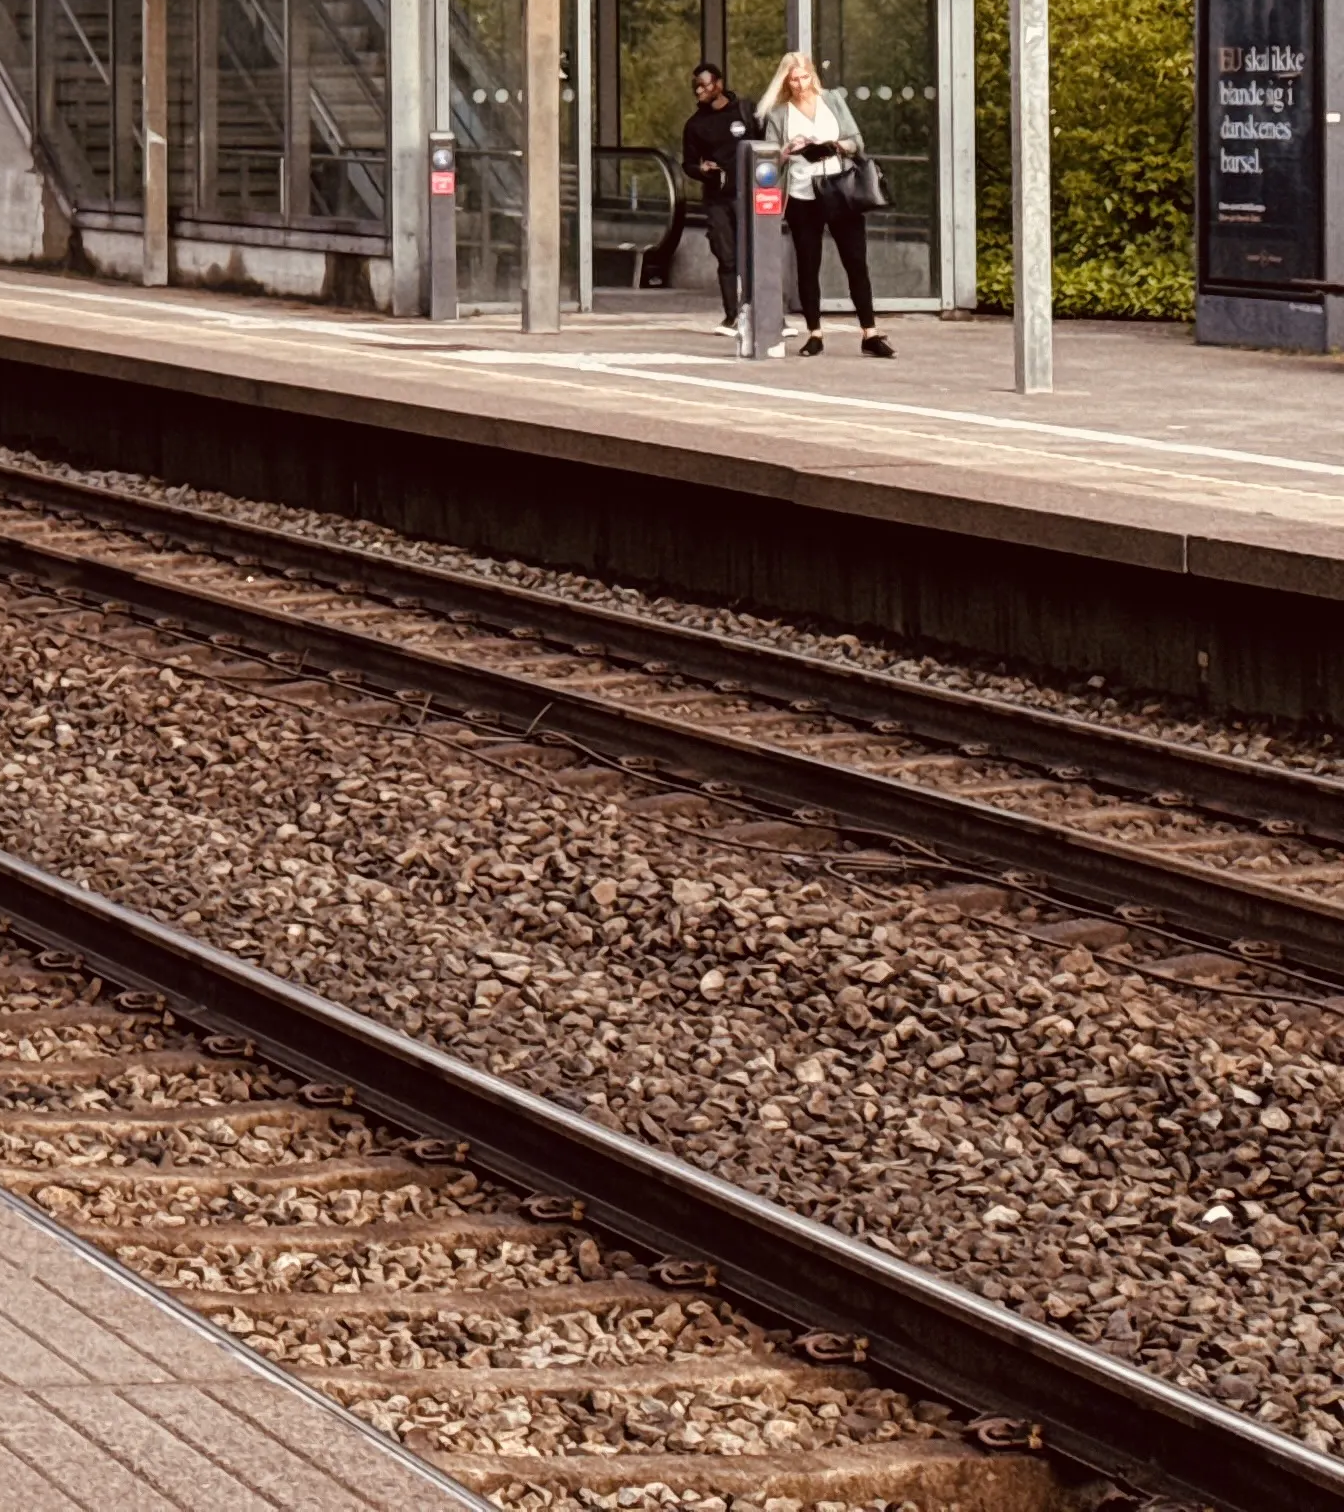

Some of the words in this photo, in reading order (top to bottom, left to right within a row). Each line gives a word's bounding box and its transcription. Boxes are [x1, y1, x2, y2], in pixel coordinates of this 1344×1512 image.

[1218, 47, 1243, 72] EU
[1245, 45, 1269, 72] skal
[1271, 45, 1305, 72] ikke
[1287, 80, 1294, 106] i
